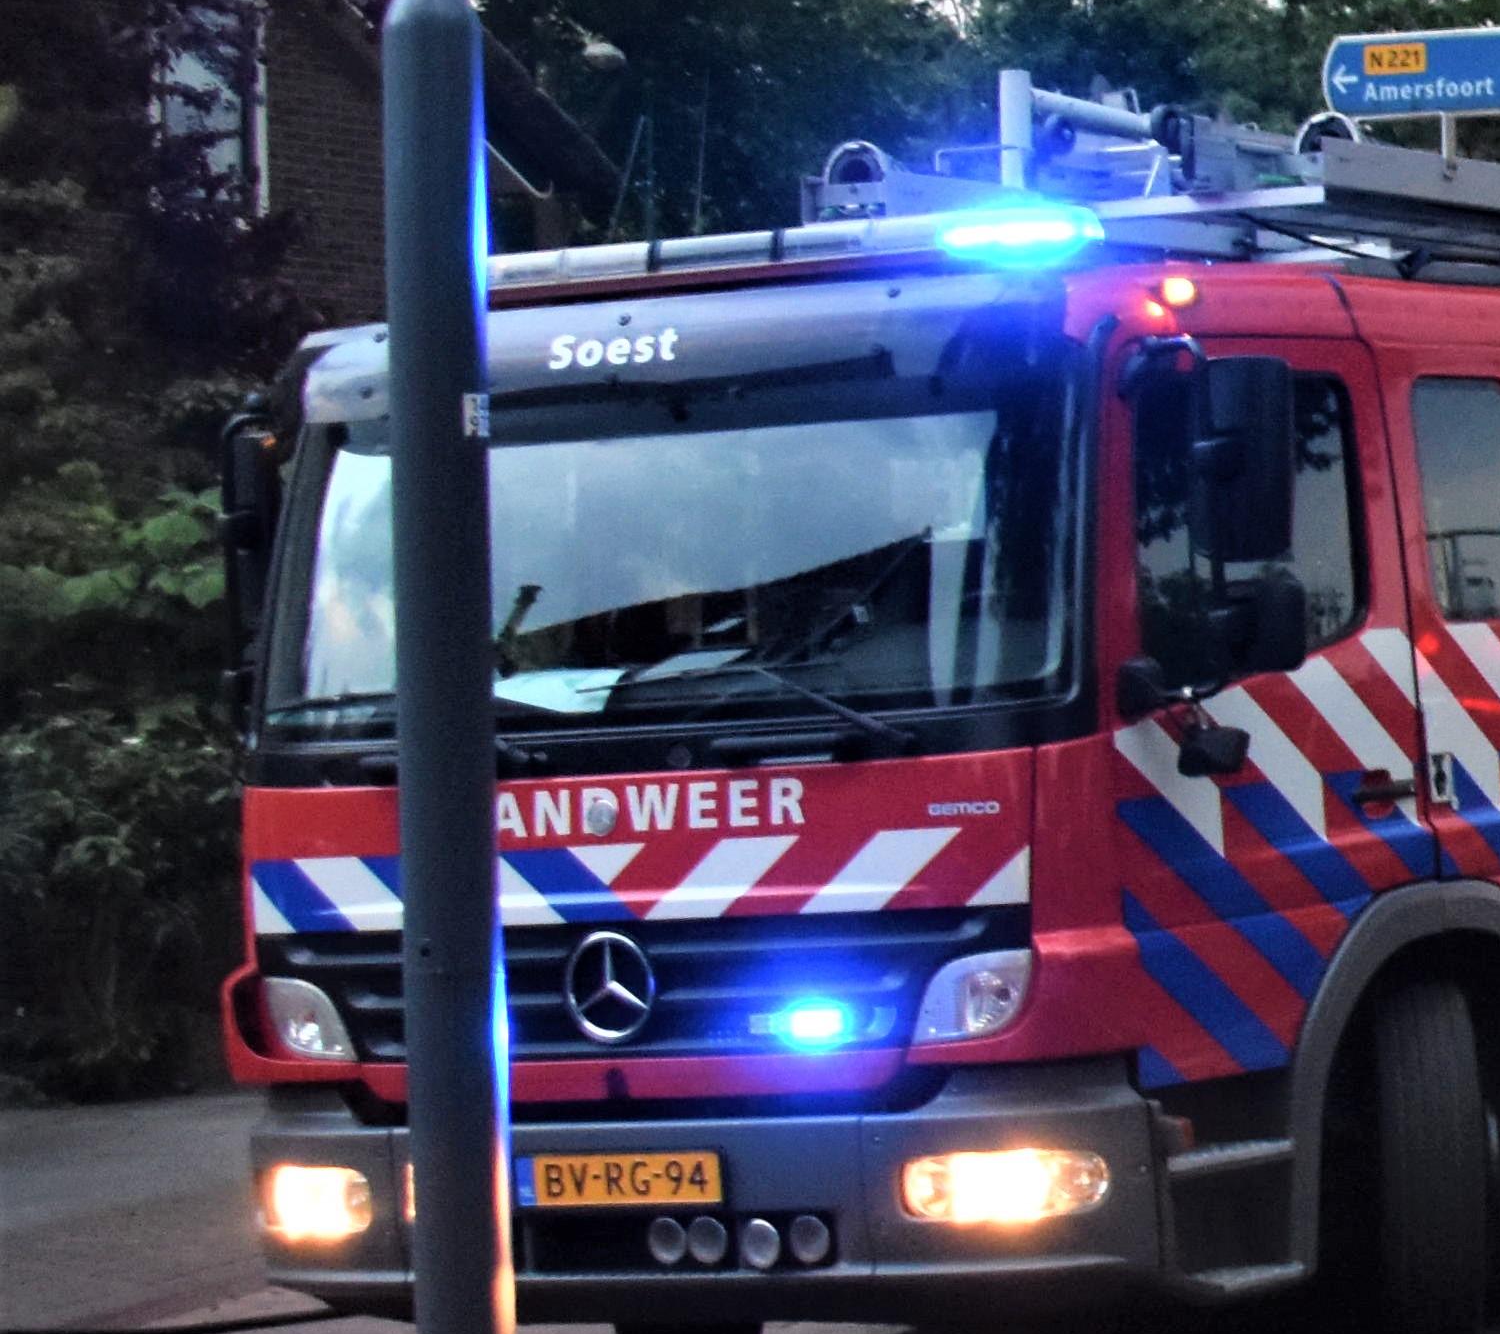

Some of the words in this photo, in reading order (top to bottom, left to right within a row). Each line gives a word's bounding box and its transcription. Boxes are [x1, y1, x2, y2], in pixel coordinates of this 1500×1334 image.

[1364, 77, 1495, 102] Amersfoort
[549, 327, 679, 370] Soest
[497, 777, 806, 839] ANDWEER
[544, 1159, 709, 1198] BV-RG-94
